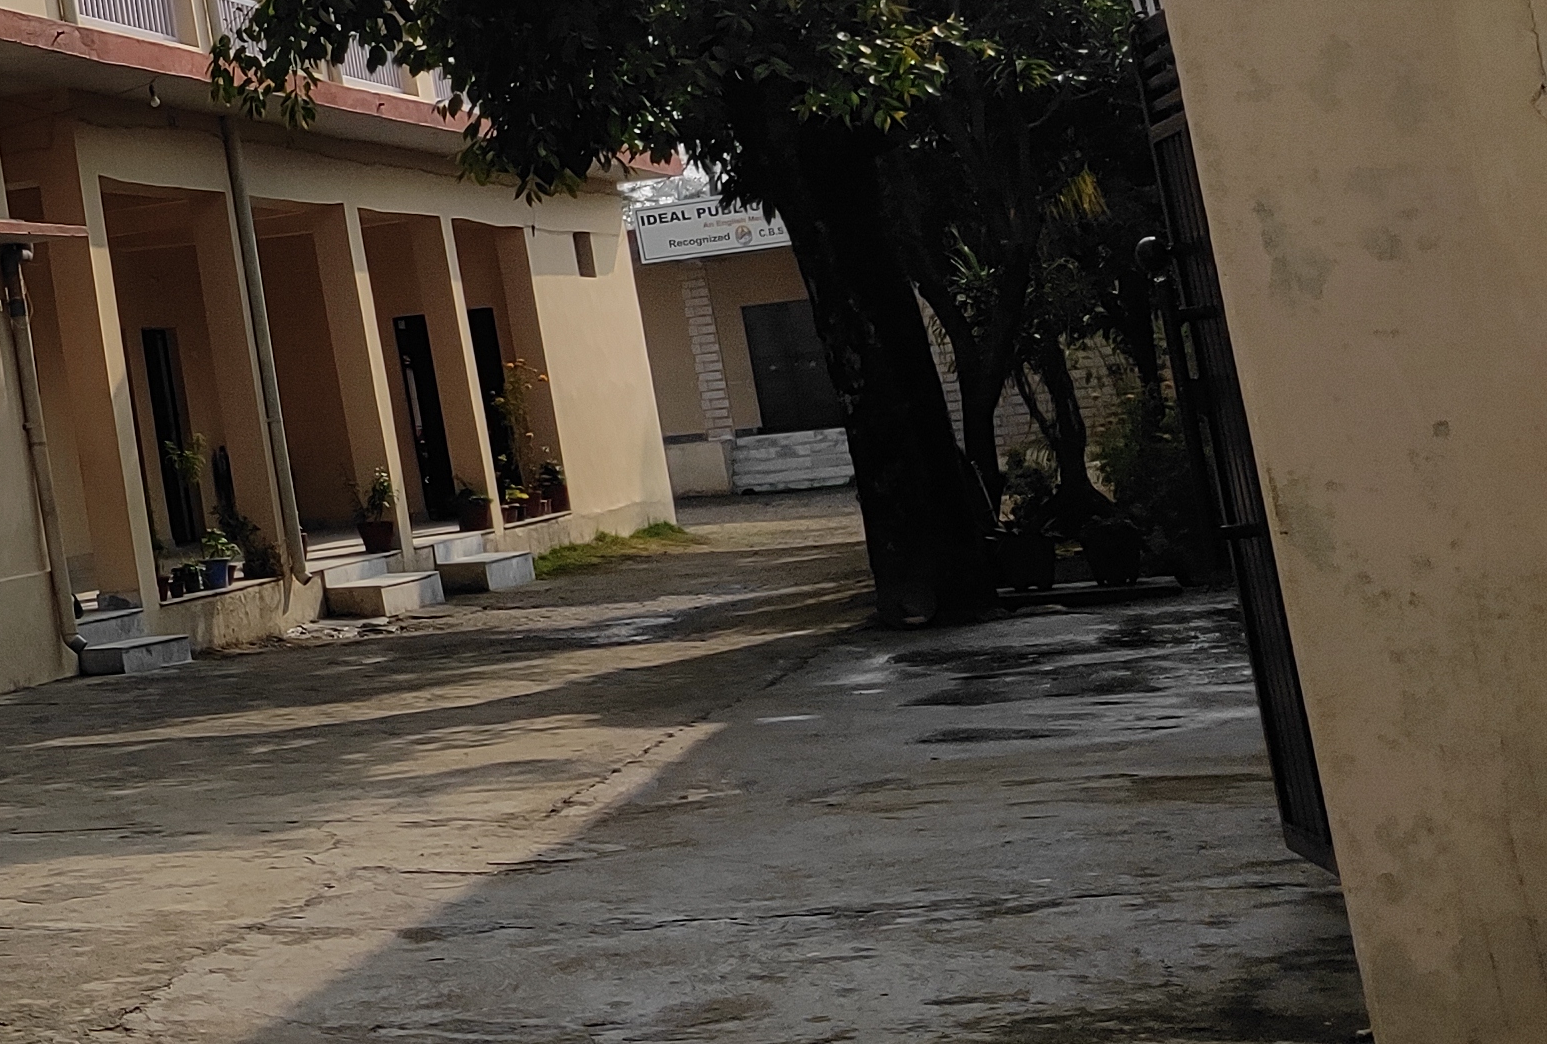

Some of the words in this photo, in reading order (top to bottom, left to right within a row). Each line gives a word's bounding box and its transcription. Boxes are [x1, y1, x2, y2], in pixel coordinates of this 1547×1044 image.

[640, 210, 692, 227] IDEAL
[696, 197, 762, 218] PUBLC
[668, 232, 731, 248] Recognized
